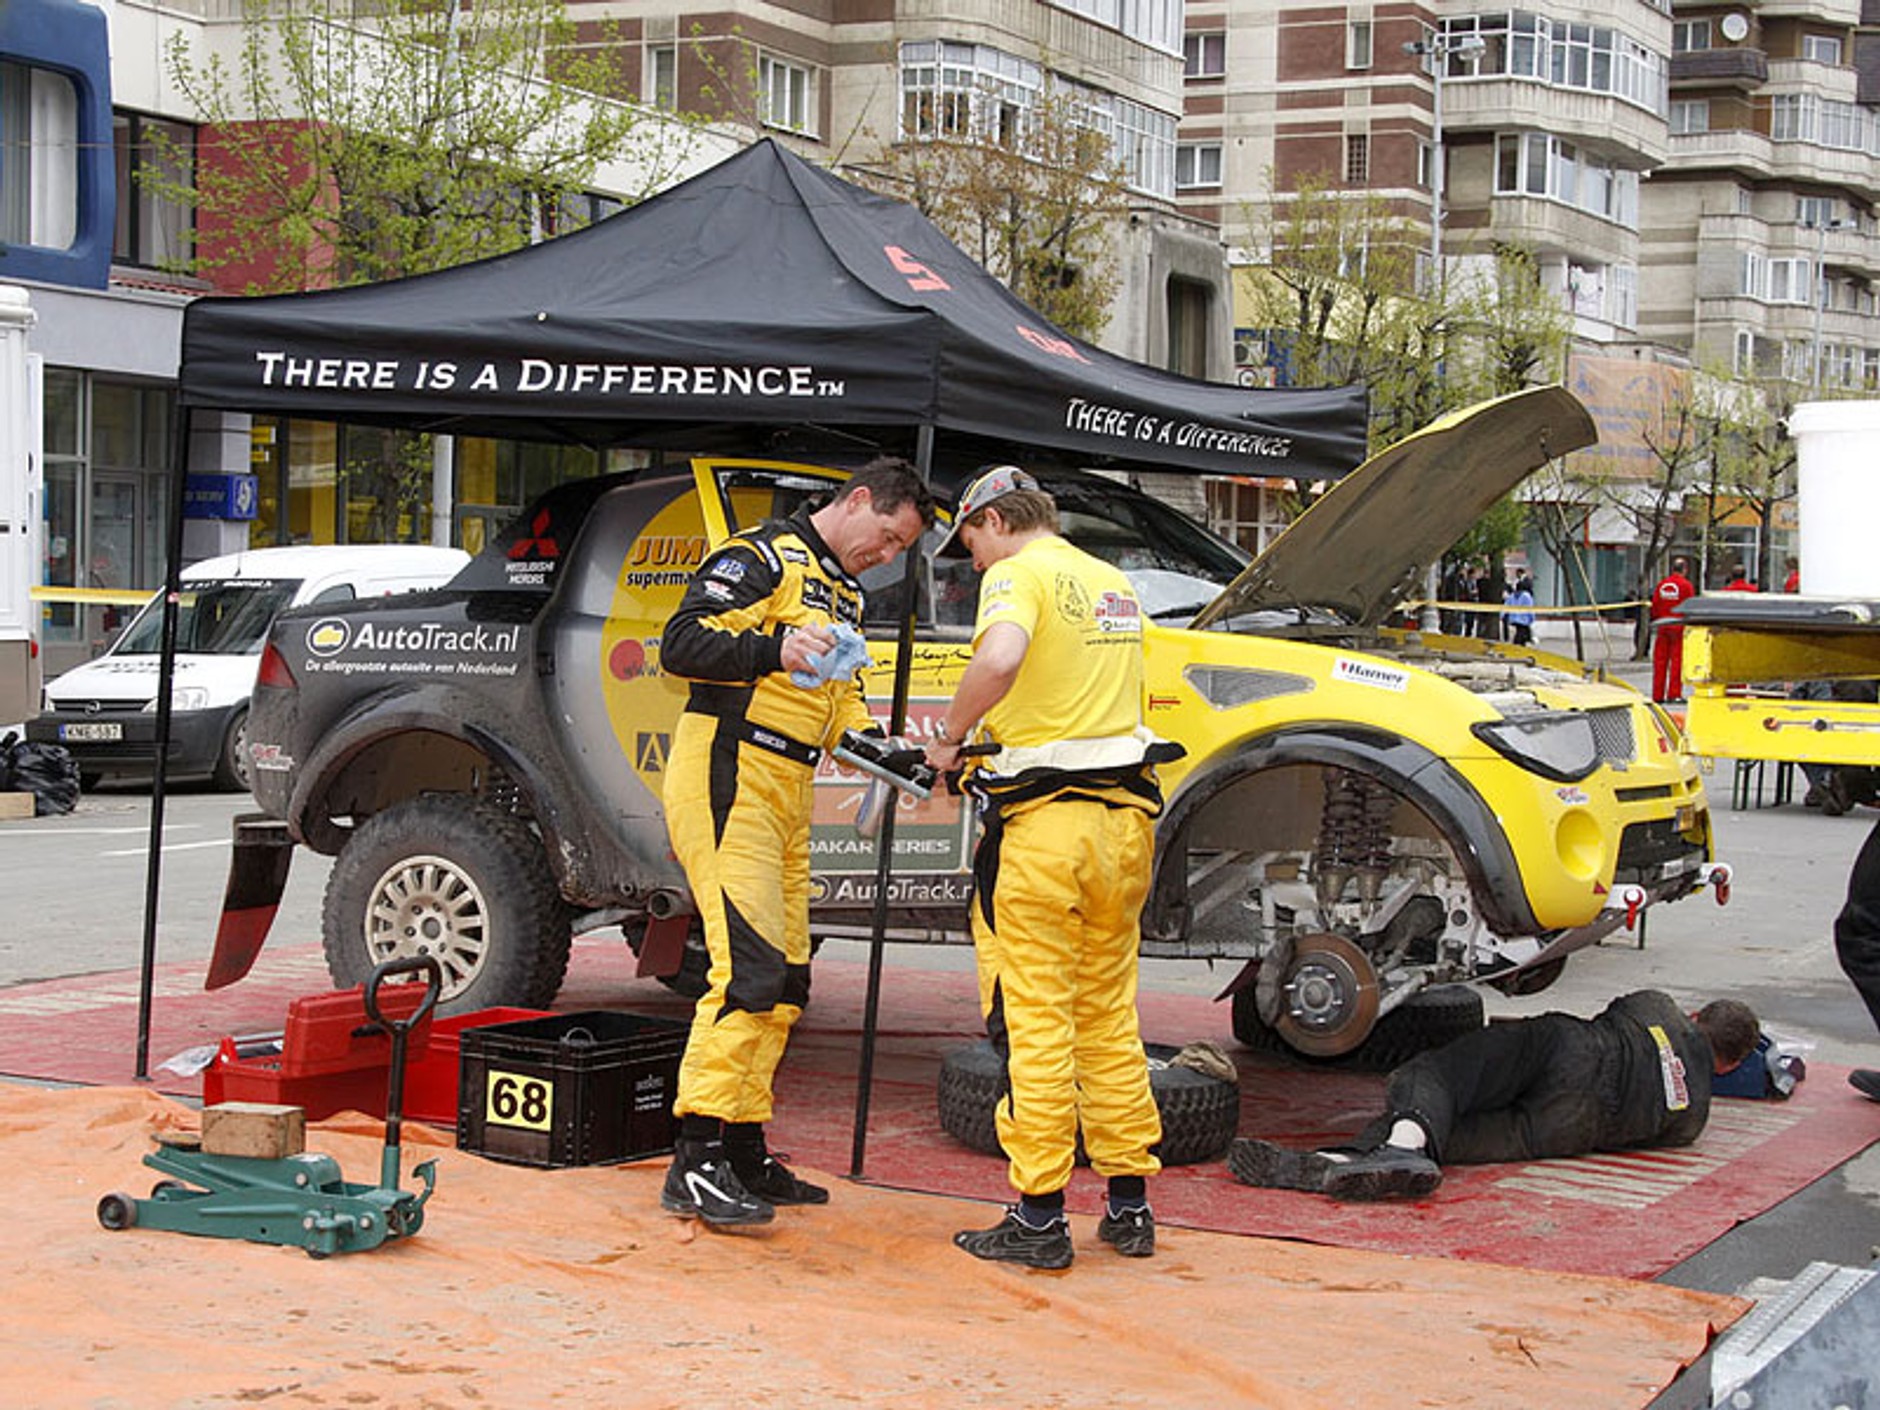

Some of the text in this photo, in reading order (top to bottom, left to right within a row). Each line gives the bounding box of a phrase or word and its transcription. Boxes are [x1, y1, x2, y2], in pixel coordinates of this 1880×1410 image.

[256, 351, 399, 389] THERE
[413, 361, 458, 390] IS
[469, 364, 500, 391] A
[1065, 398, 1135, 437] THERE
[1134, 415, 1158, 441] IS
[1157, 420, 1175, 445] A
[629, 535, 711, 566] JUM
[625, 571, 694, 590] superma
[352, 622, 521, 653] AutoTrack.nl
[305, 658, 321, 673] De
[456, 661, 518, 677] Nederland
[889, 838, 951, 855] ERIES
[835, 877, 974, 901] AutoTrack.n
[491, 1076, 548, 1124] 68
